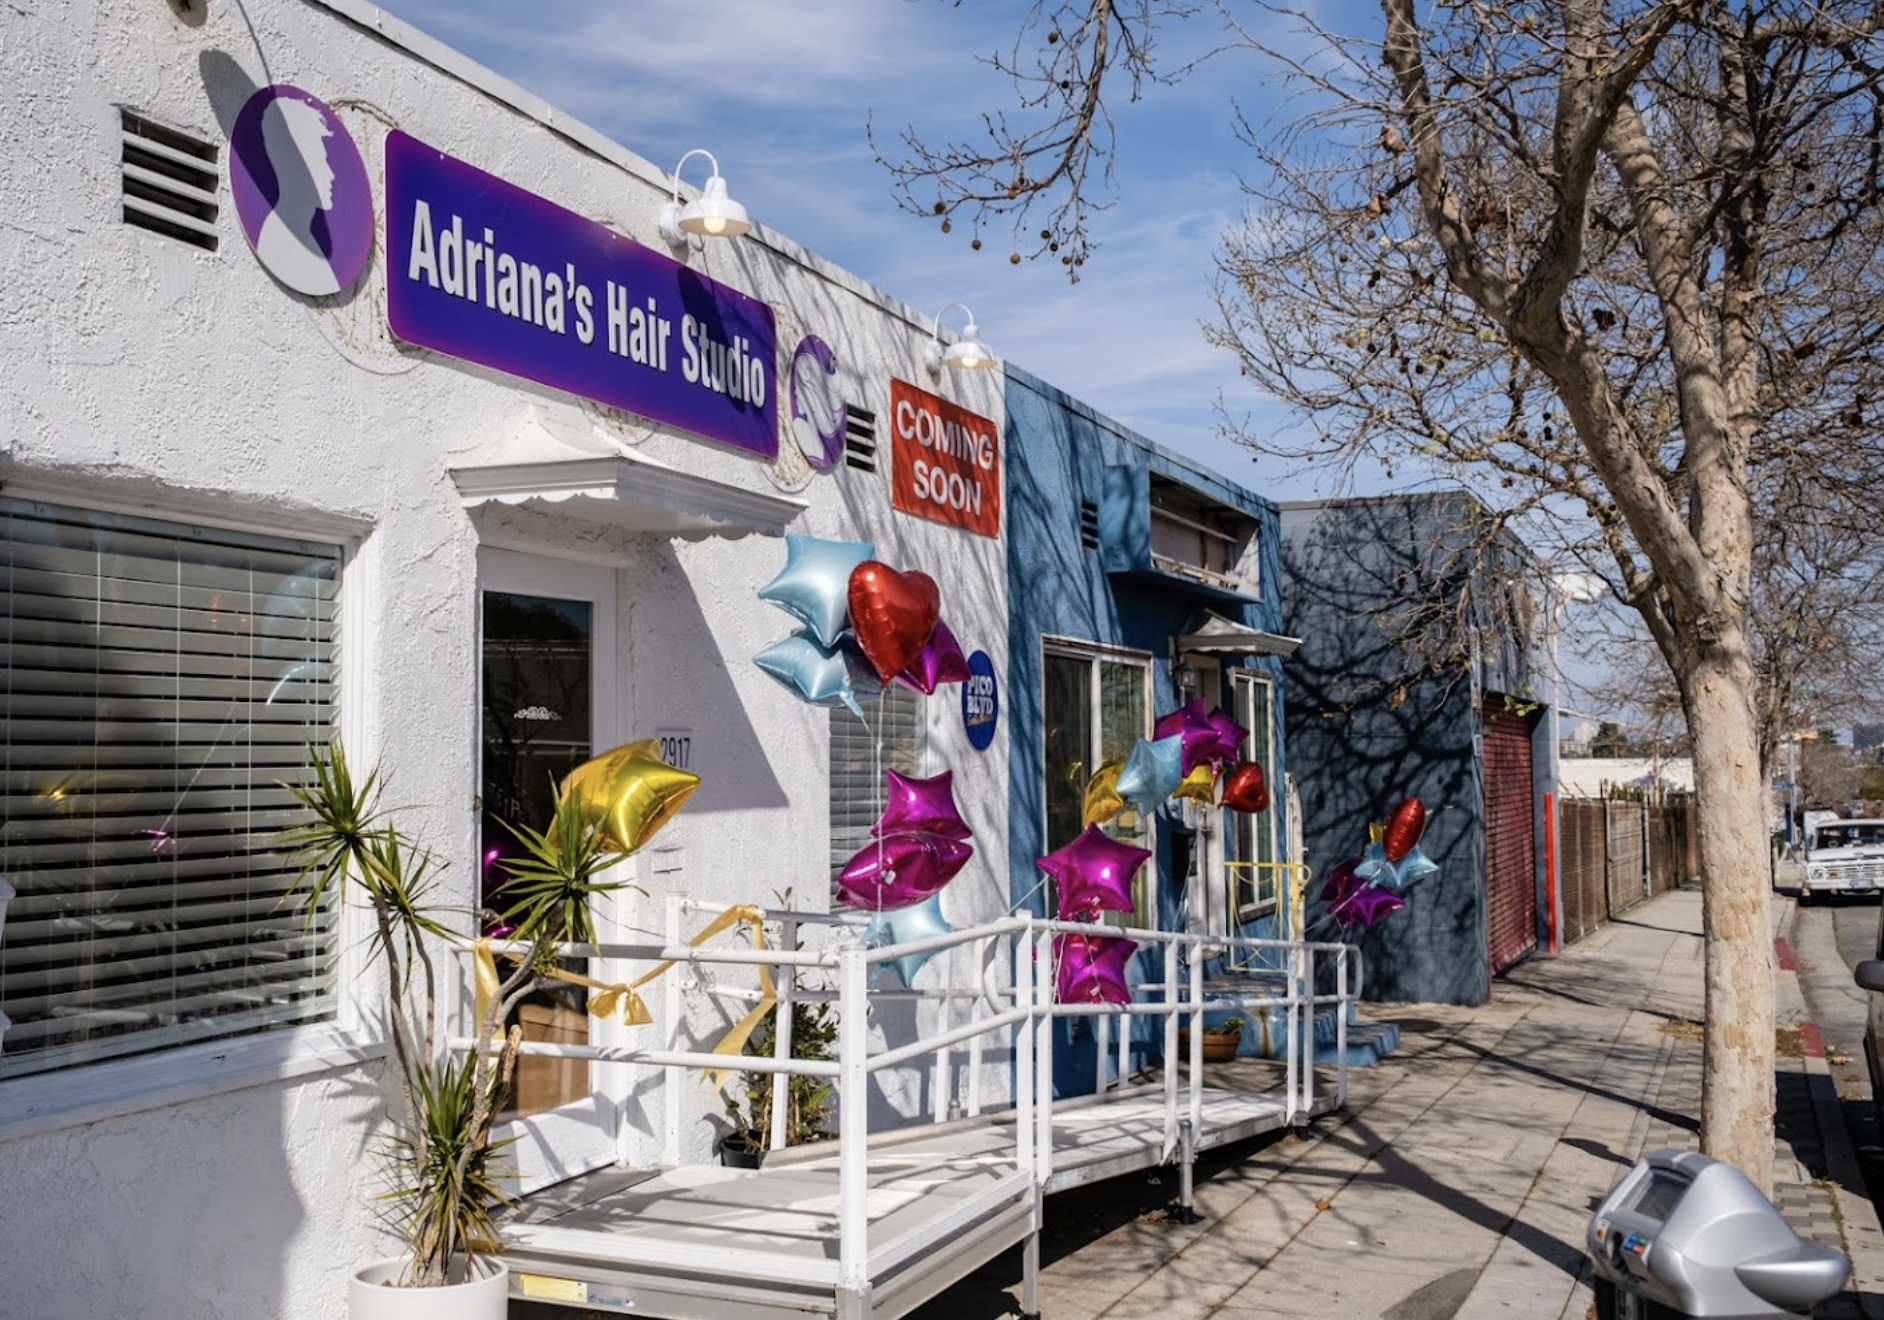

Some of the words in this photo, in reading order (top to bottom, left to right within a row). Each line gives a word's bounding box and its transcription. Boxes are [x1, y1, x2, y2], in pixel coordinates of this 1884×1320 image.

[408, 199, 595, 345] Adriana's
[607, 280, 671, 372] Hair
[681, 314, 765, 408] Studio
[896, 400, 994, 470] COMING
[913, 459, 981, 516] SOON
[967, 675, 993, 695] PICO
[967, 695, 993, 714] BLVD
[661, 737, 691, 768] 2917
